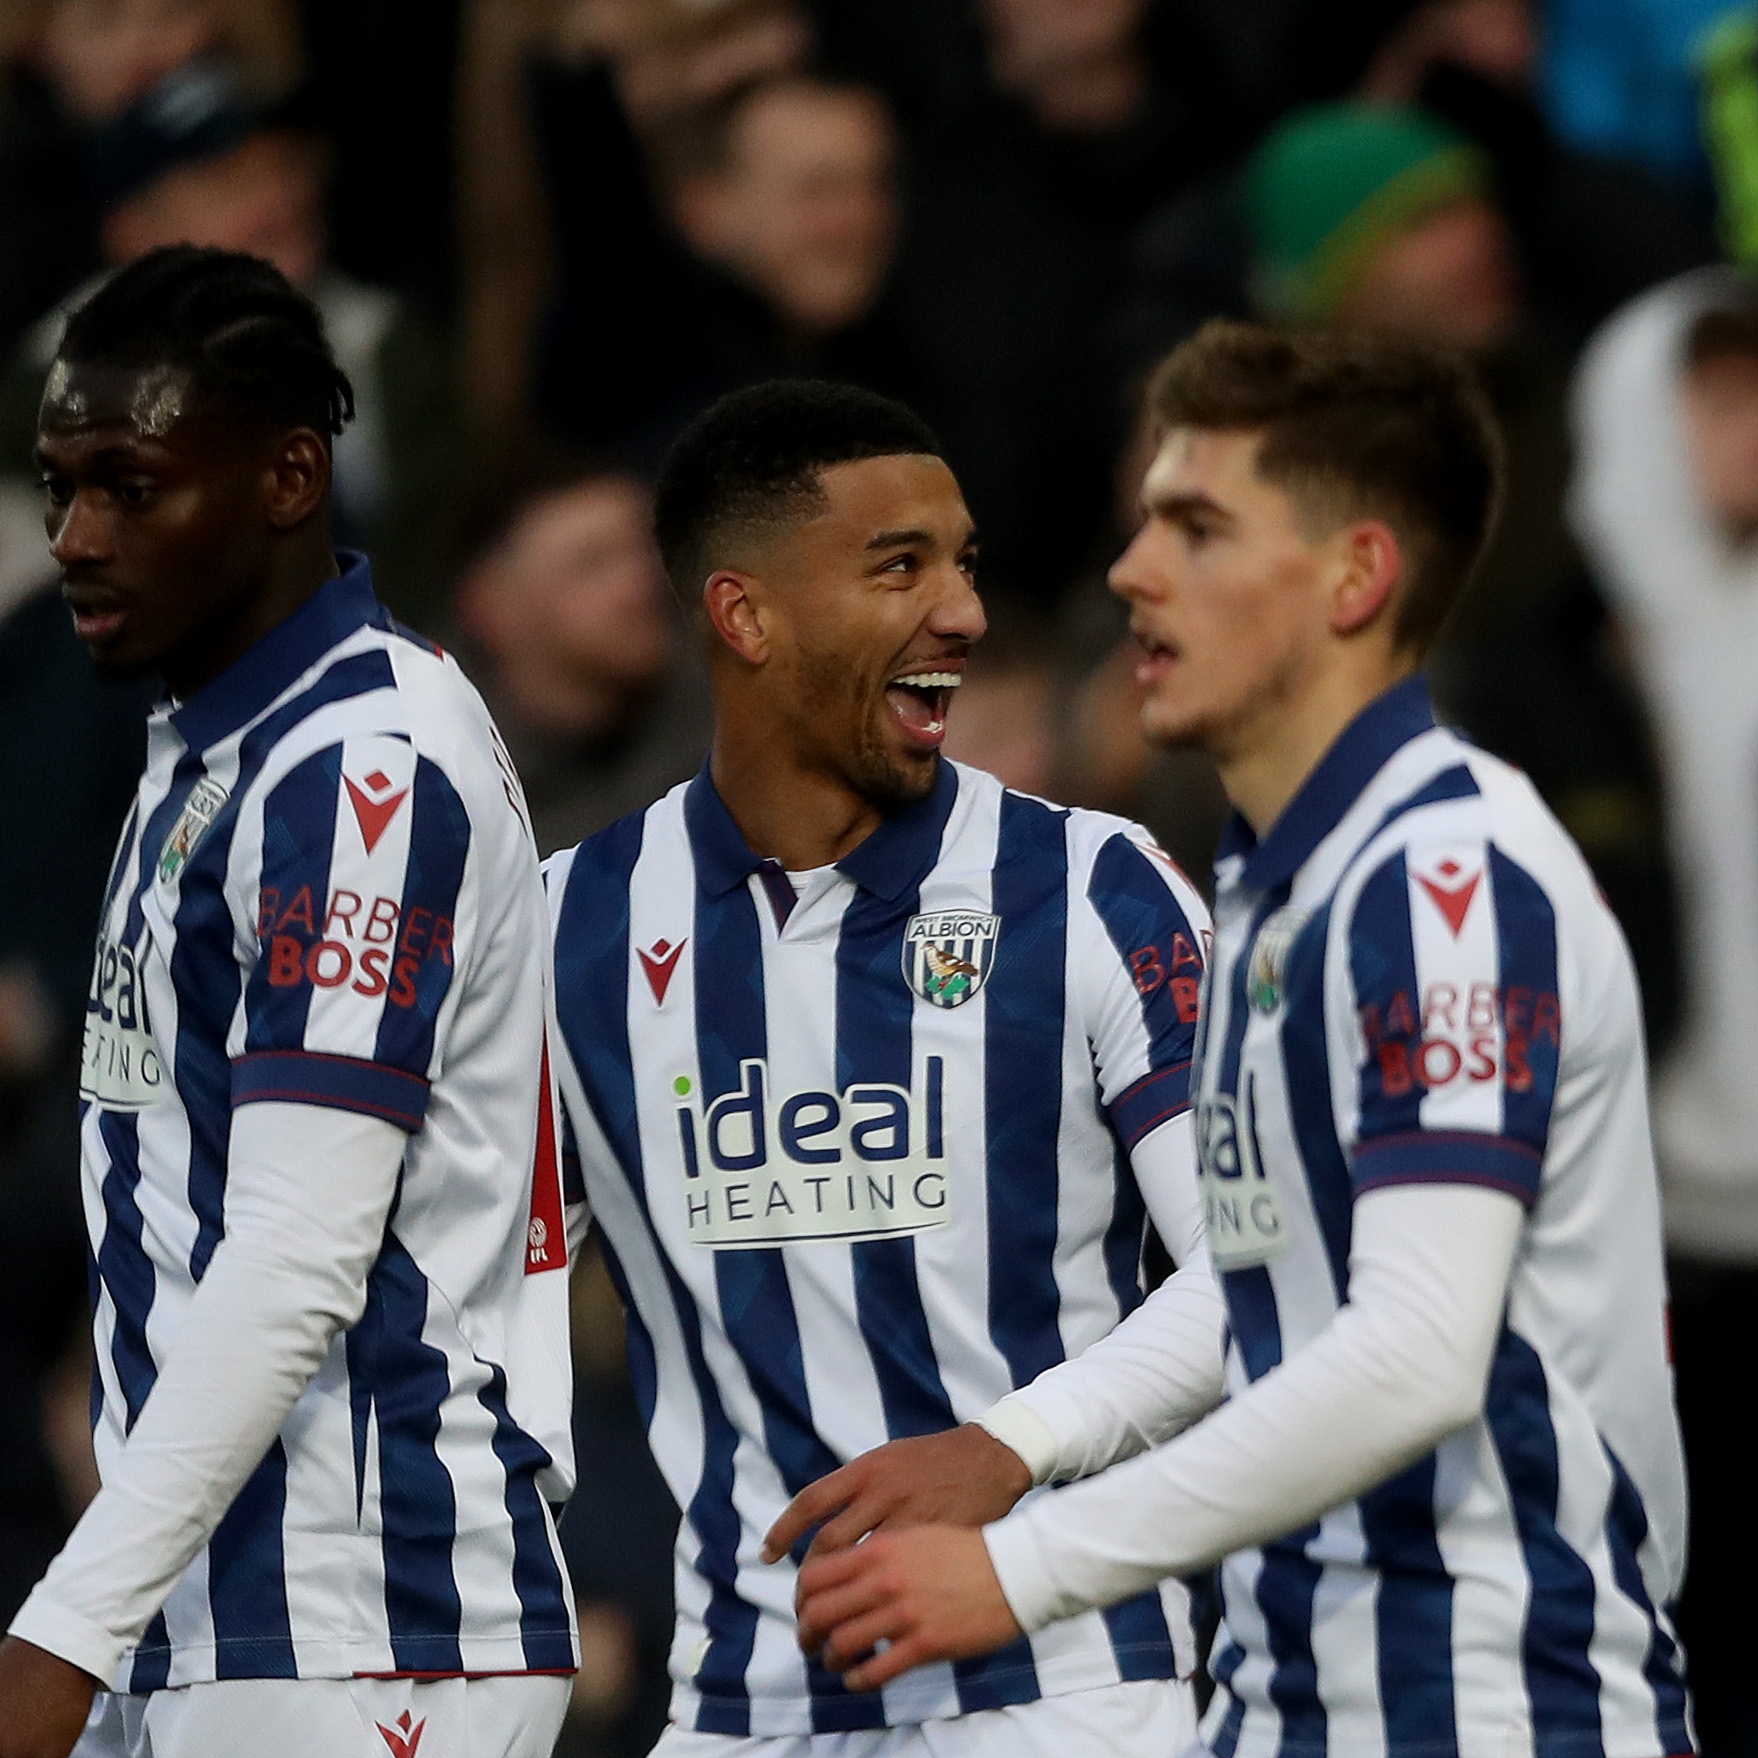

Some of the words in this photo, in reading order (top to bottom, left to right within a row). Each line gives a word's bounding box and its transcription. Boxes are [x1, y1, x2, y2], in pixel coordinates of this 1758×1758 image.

[257, 884, 455, 966] BARBER
[911, 922, 993, 938] ALBION
[268, 935, 420, 1008] BOSS
[1380, 1040, 1534, 1096] BOSS
[672, 1055, 944, 1178] ideal
[685, 1172, 947, 1230] HEATING
